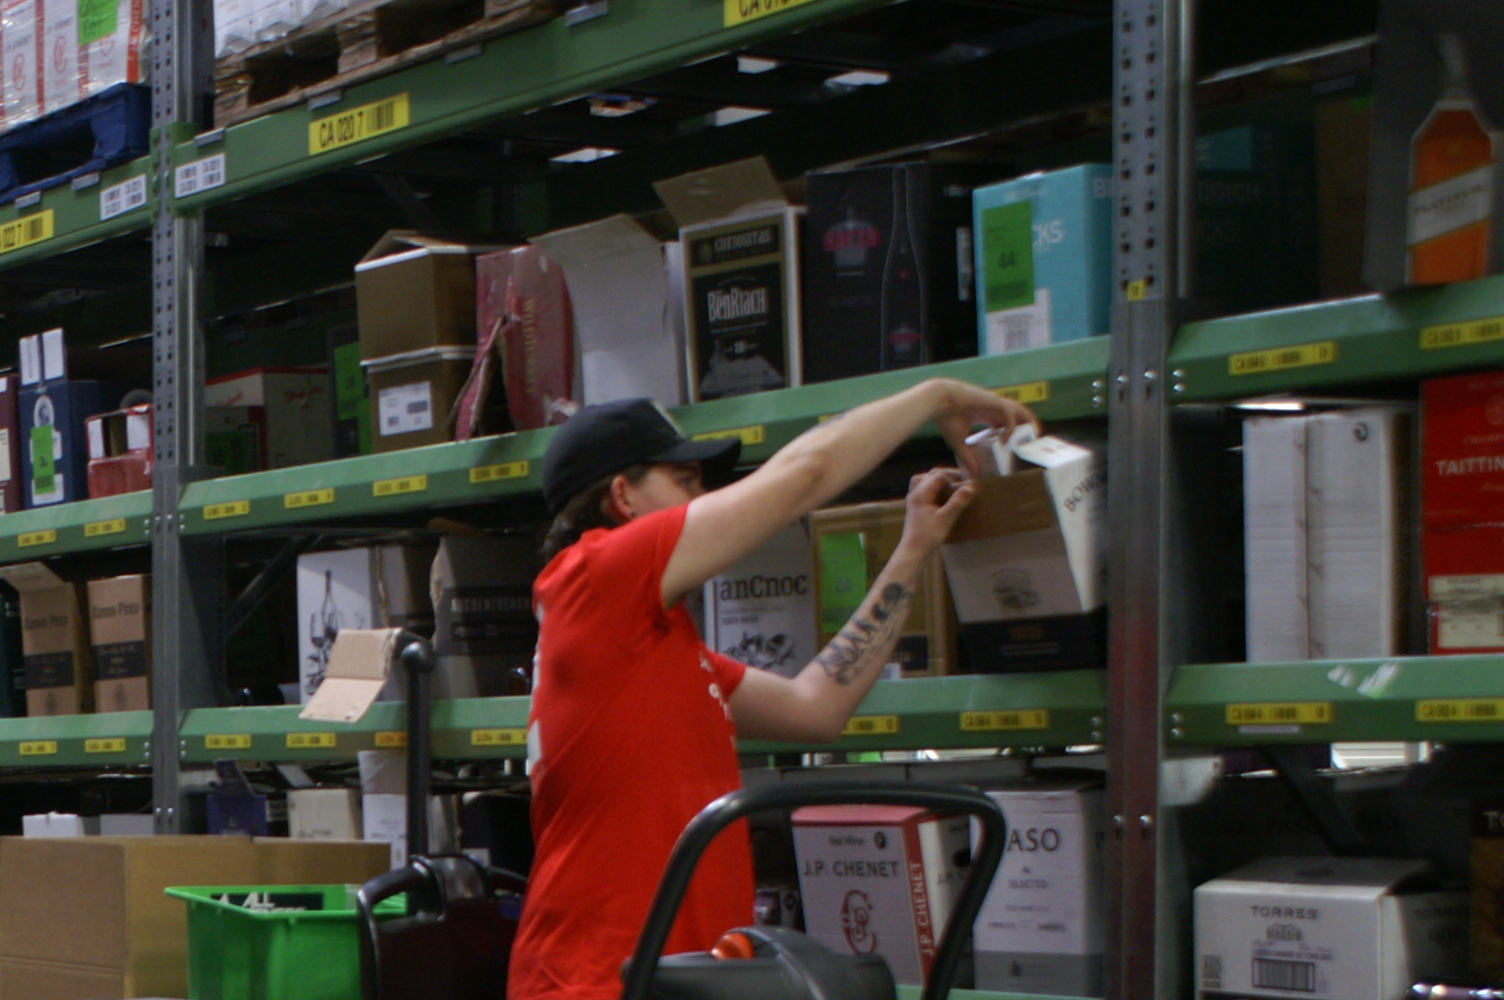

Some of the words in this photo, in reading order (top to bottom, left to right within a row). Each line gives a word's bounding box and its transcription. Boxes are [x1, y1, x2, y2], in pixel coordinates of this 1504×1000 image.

[319, 121, 335, 149] CA
[719, 574, 807, 601] anCnoc
[1007, 828, 1061, 852] ASO
[832, 860, 899, 877] CHENET
[1250, 905, 1318, 921] TORRES
